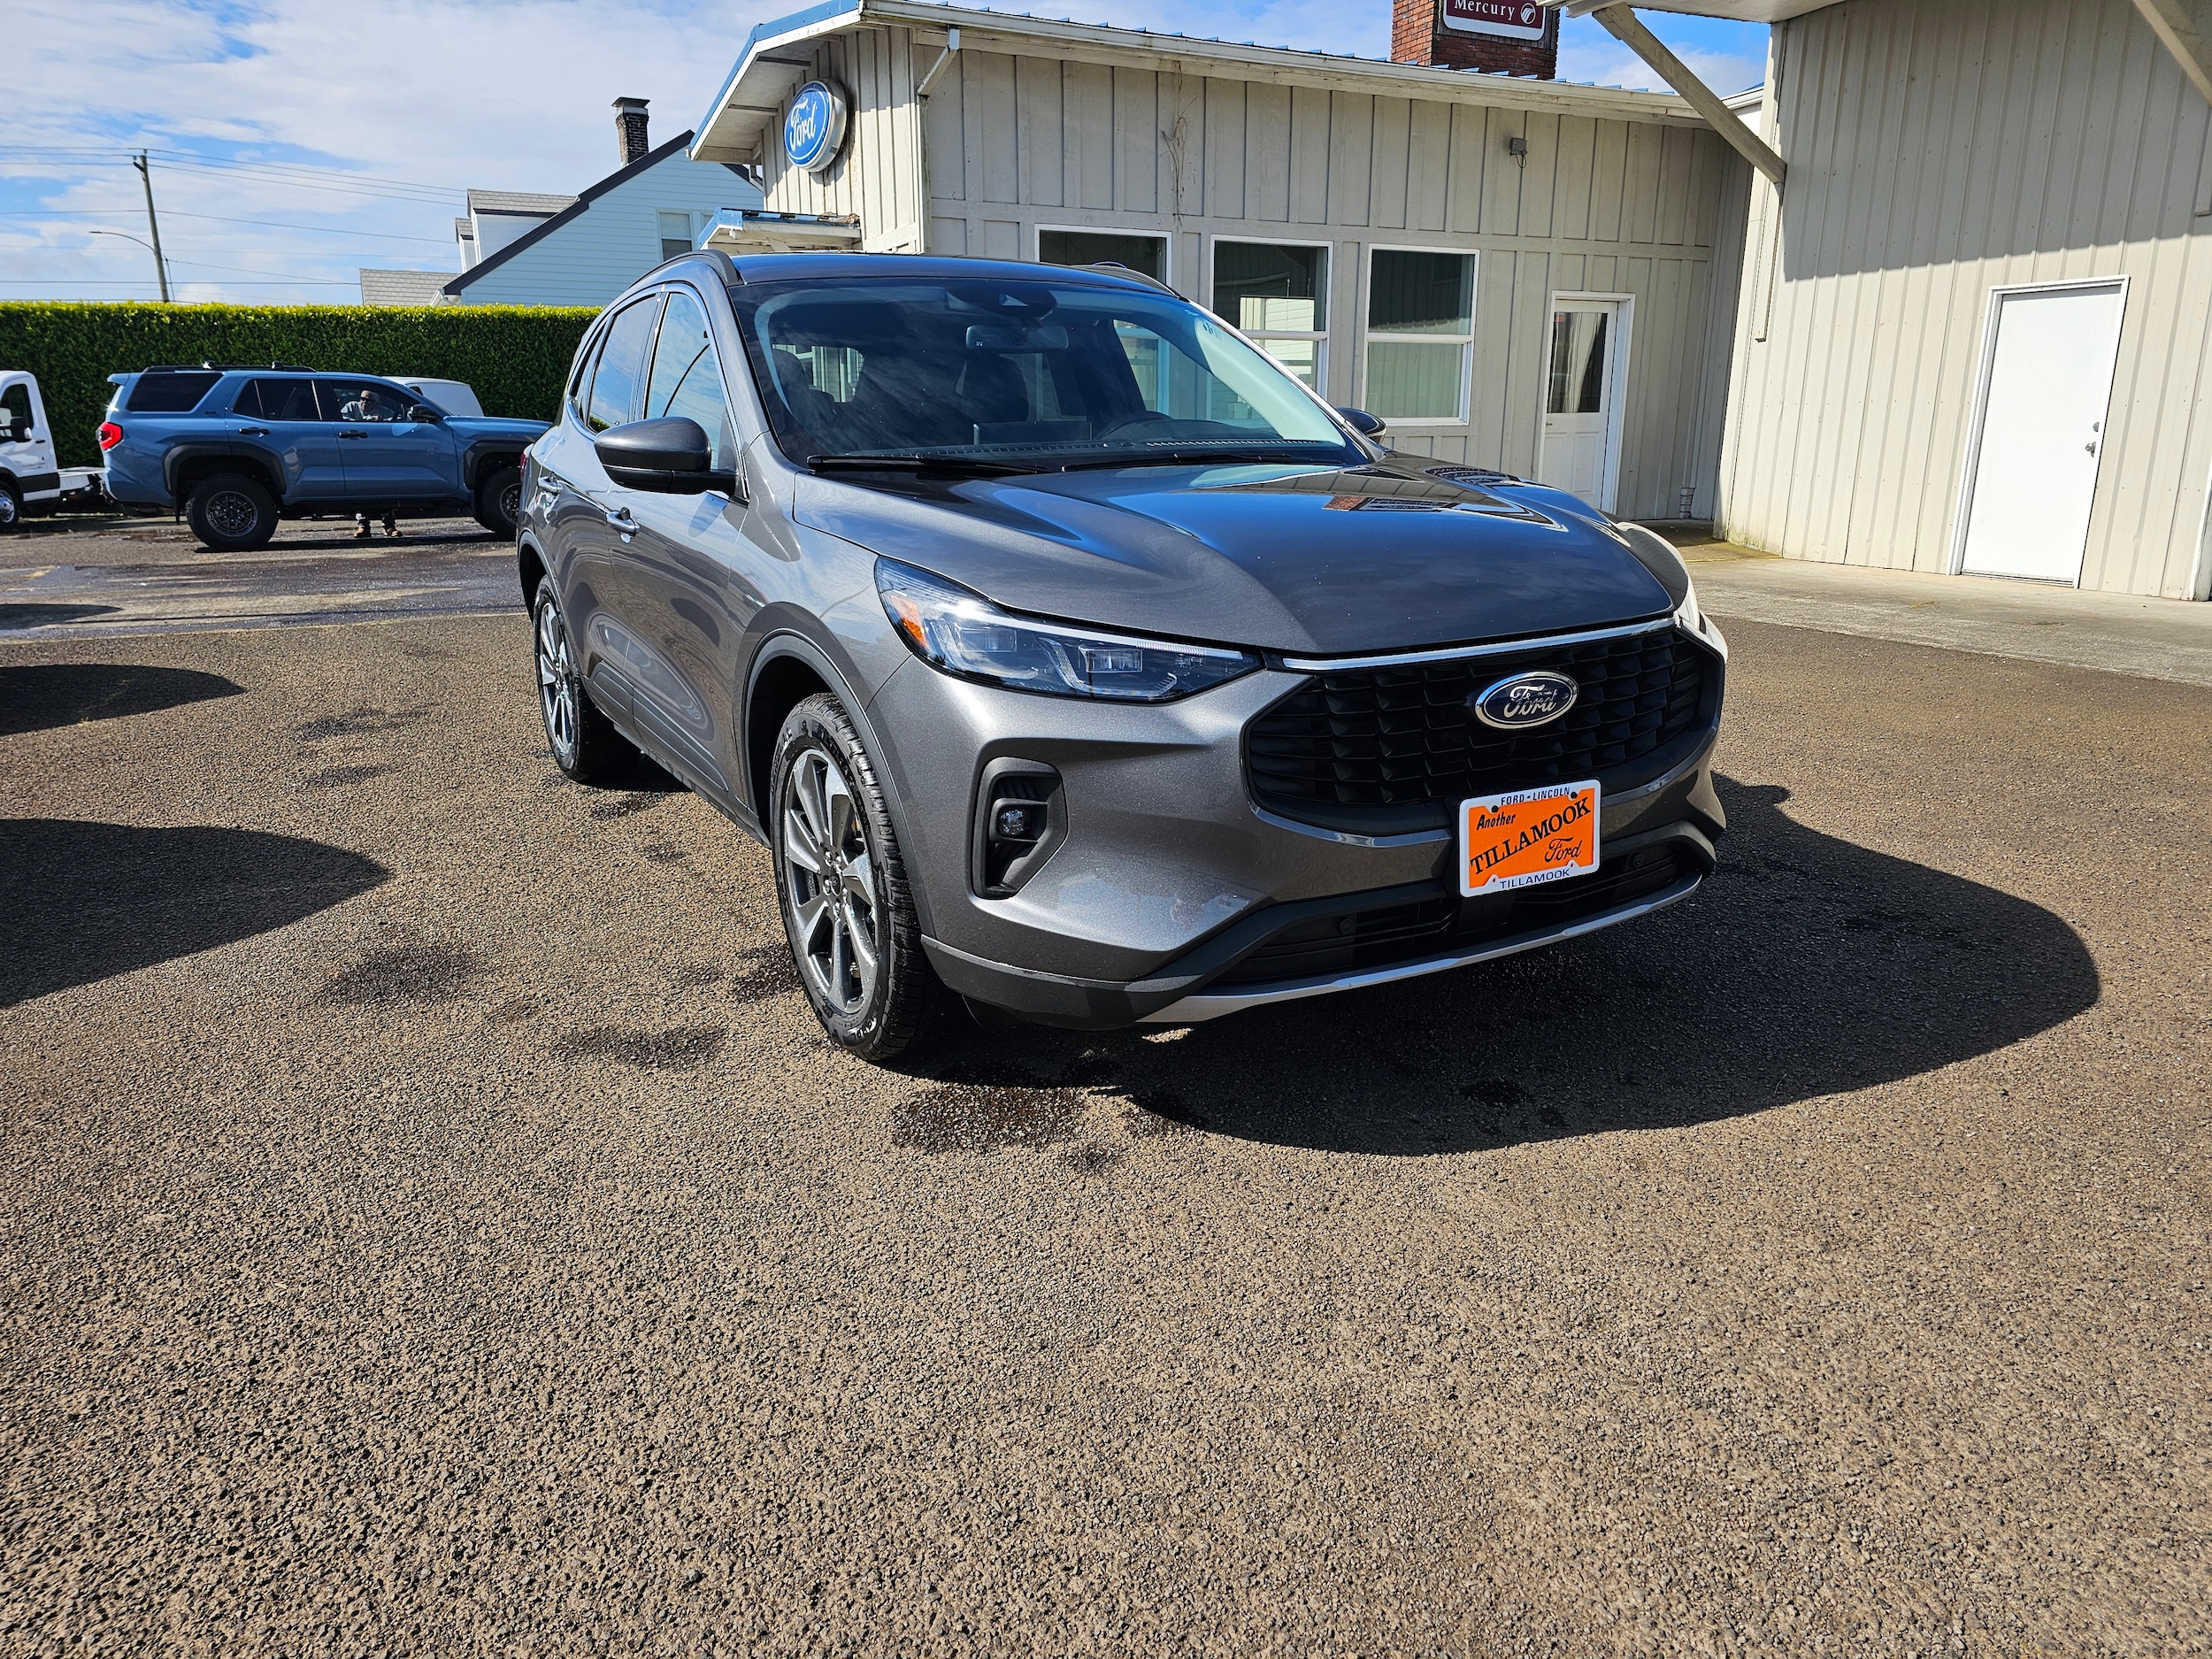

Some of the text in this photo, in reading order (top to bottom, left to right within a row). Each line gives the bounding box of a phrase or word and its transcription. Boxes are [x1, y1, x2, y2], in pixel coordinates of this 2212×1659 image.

[1454, 0, 1516, 20] Mercury
[790, 96, 817, 152] Ford
[1503, 684, 1558, 718] Ford
[1501, 787, 1570, 806] FORD LINCOLN
[1476, 811, 1516, 831] Another
[1470, 796, 1591, 875] TILLAMOOK
[1544, 836, 1583, 863] Ford
[1500, 868, 1570, 889] TILLAMOOK
